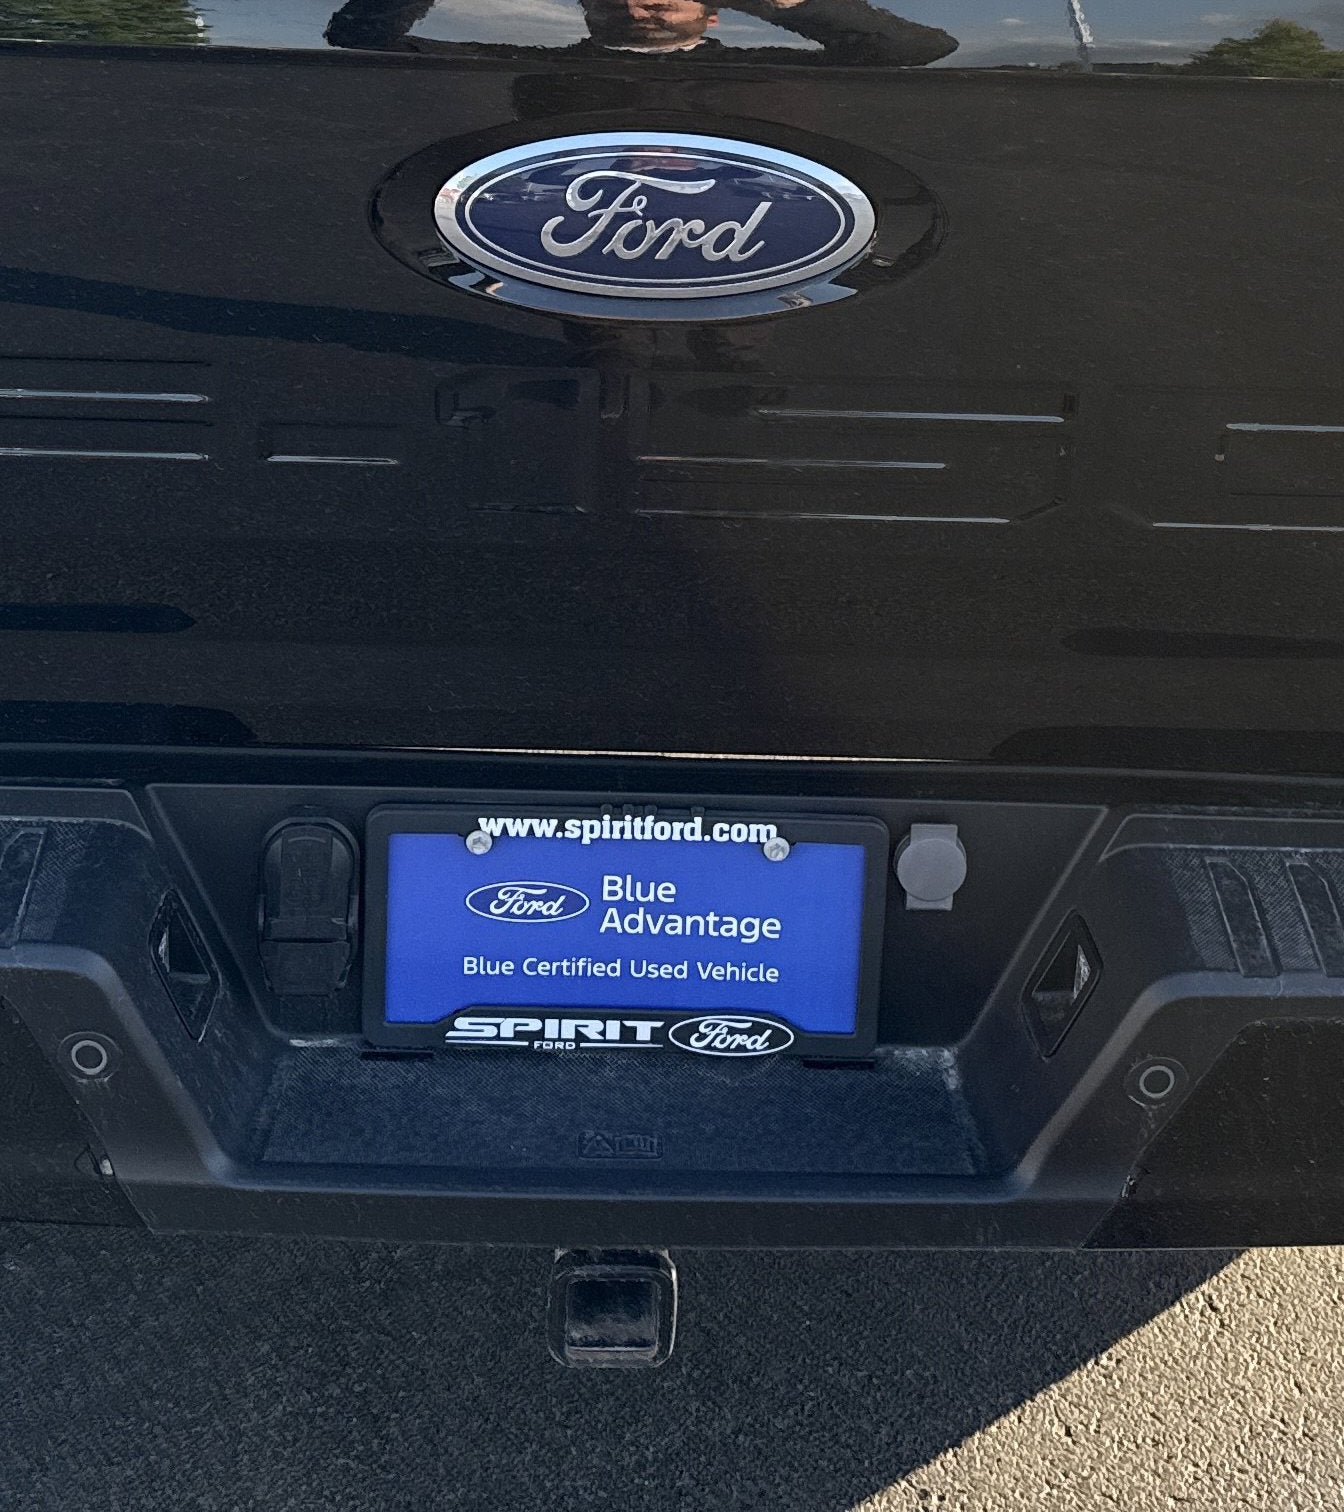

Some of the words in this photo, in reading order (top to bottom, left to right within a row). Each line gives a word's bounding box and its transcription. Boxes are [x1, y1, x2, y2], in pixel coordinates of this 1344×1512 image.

[540, 169, 773, 262] Ford
[477, 814, 778, 845] www.spiritford.com
[489, 885, 564, 916] Ford
[602, 874, 677, 903] Blue
[599, 906, 783, 944] Advantage
[462, 955, 515, 976] Blue
[522, 956, 622, 978] Certified
[629, 959, 689, 980] Used
[696, 961, 780, 984] Vehicle
[444, 1016, 666, 1042] SPIRIT
[689, 1017, 773, 1052] Ford
[533, 1040, 576, 1051] FORD
